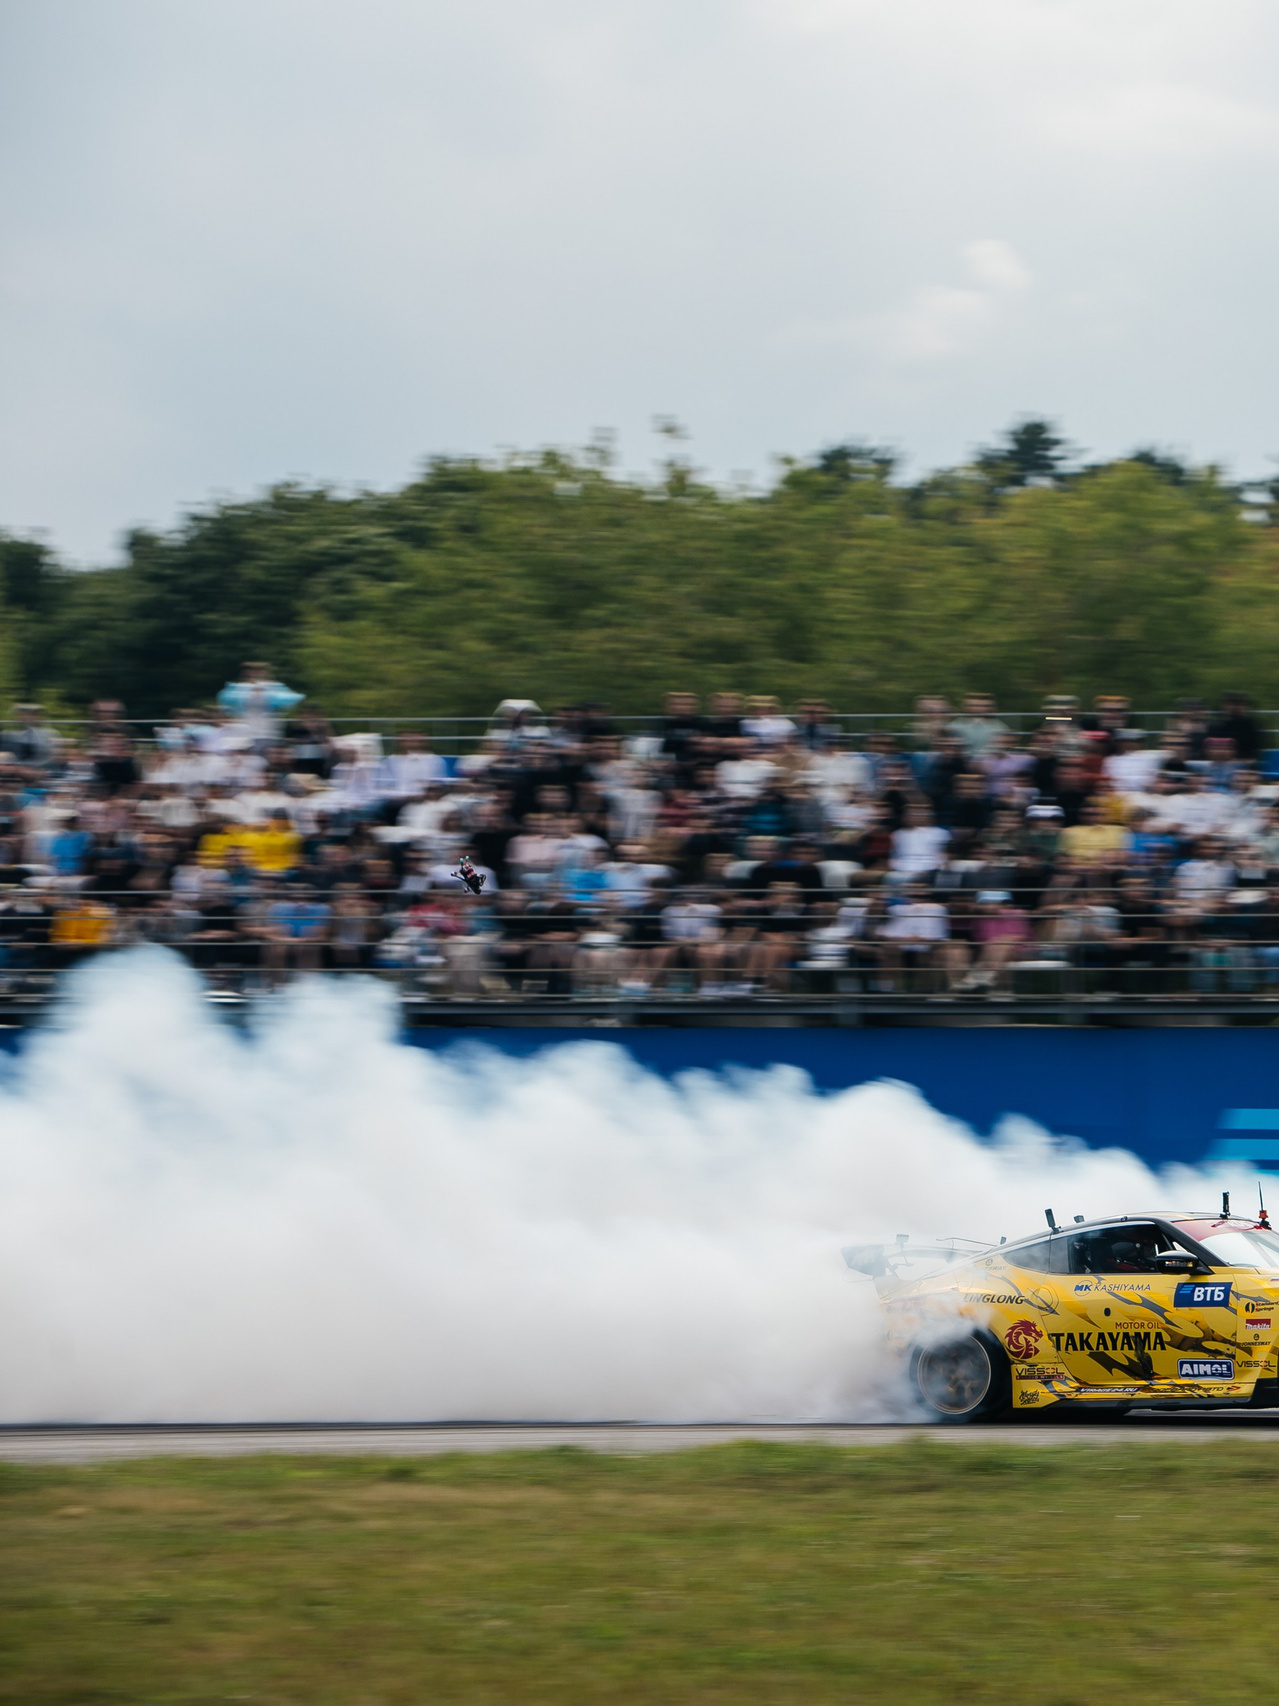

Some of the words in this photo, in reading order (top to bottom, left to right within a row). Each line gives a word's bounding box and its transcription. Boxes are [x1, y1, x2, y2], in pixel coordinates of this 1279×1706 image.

[1094, 1284, 1150, 1292] KASHIYAMA
[1193, 1286, 1226, 1302] ВТБ
[1115, 1322, 1146, 1330] MOTOR
[1147, 1322, 1161, 1330] OIL
[1052, 1331, 1167, 1351] TAKAYAMA
[1236, 1360, 1277, 1368] VISSOL
[1015, 1367, 1065, 1375] VISSOL
[1181, 1363, 1231, 1375] AIMOL
